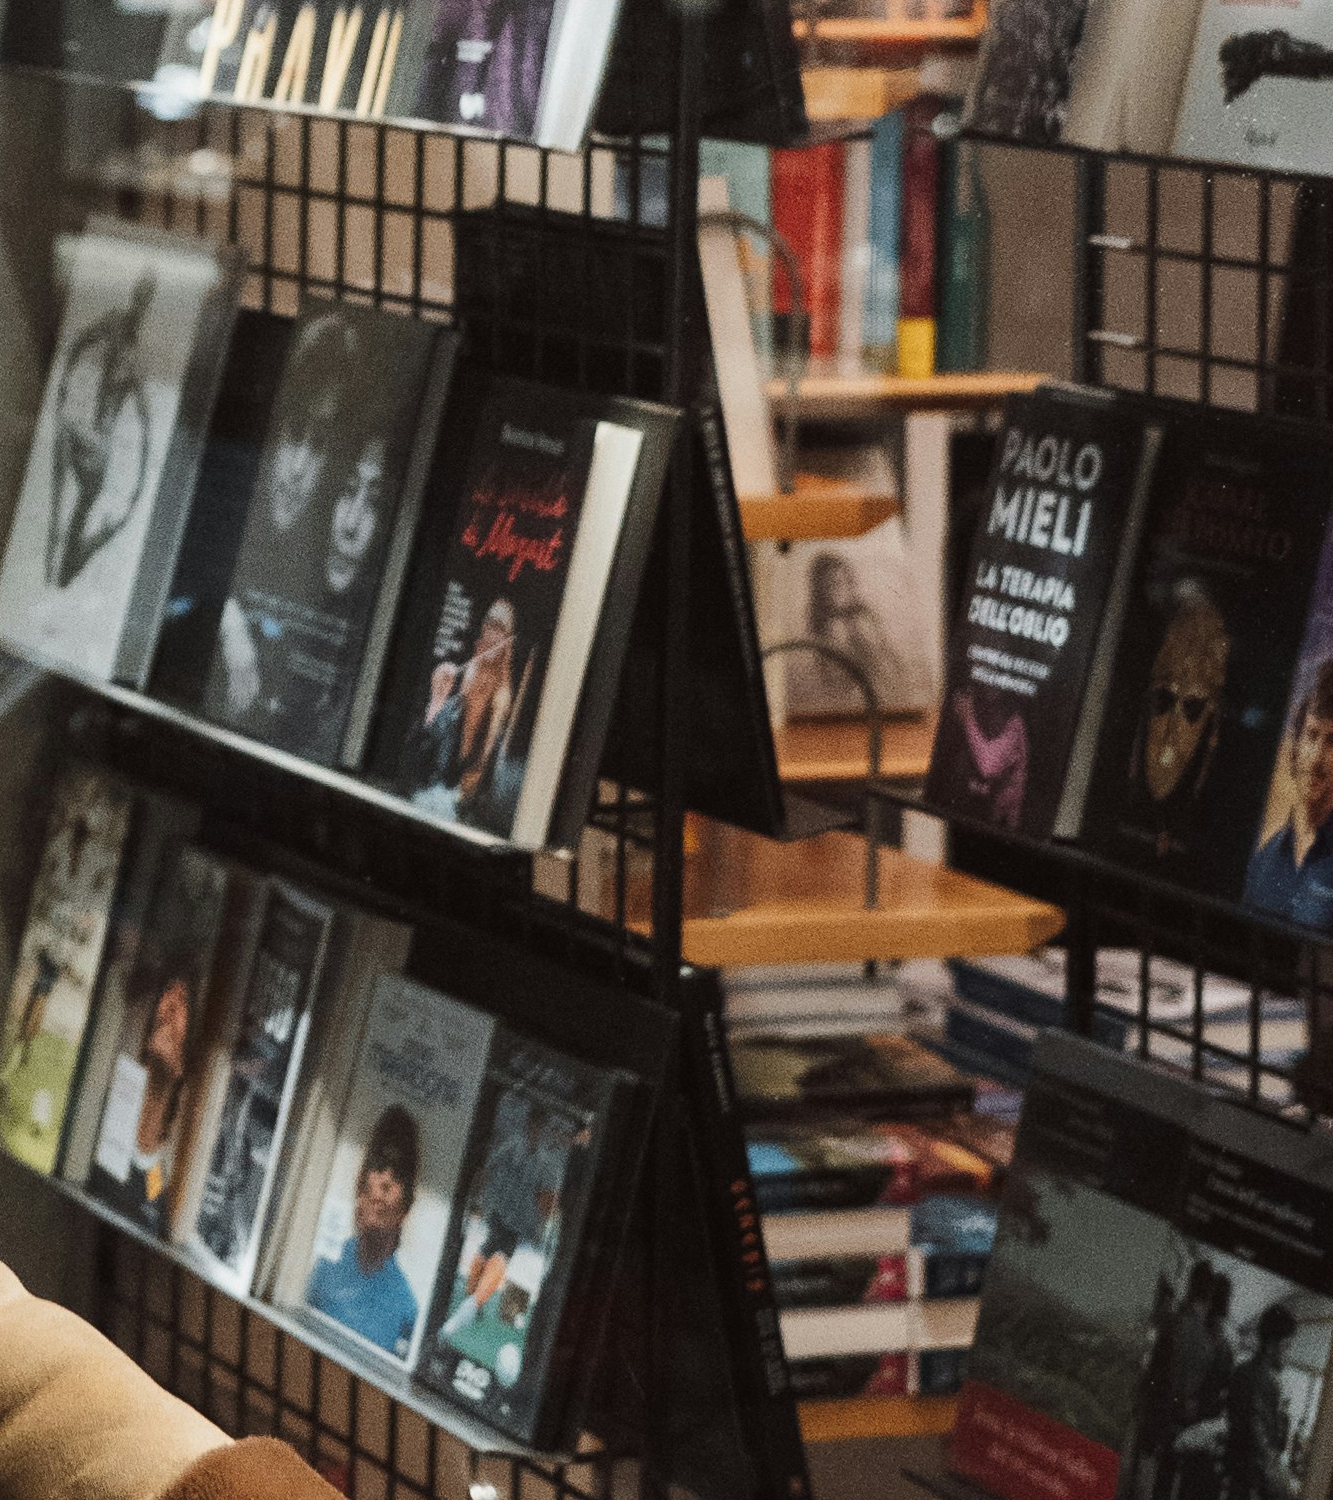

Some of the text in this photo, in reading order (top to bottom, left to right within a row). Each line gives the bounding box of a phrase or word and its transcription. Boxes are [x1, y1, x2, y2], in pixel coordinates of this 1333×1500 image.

[998, 427, 1103, 491] PAOLO
[986, 484, 1093, 558] MIELI
[975, 558, 1076, 612] LA TERAPIA
